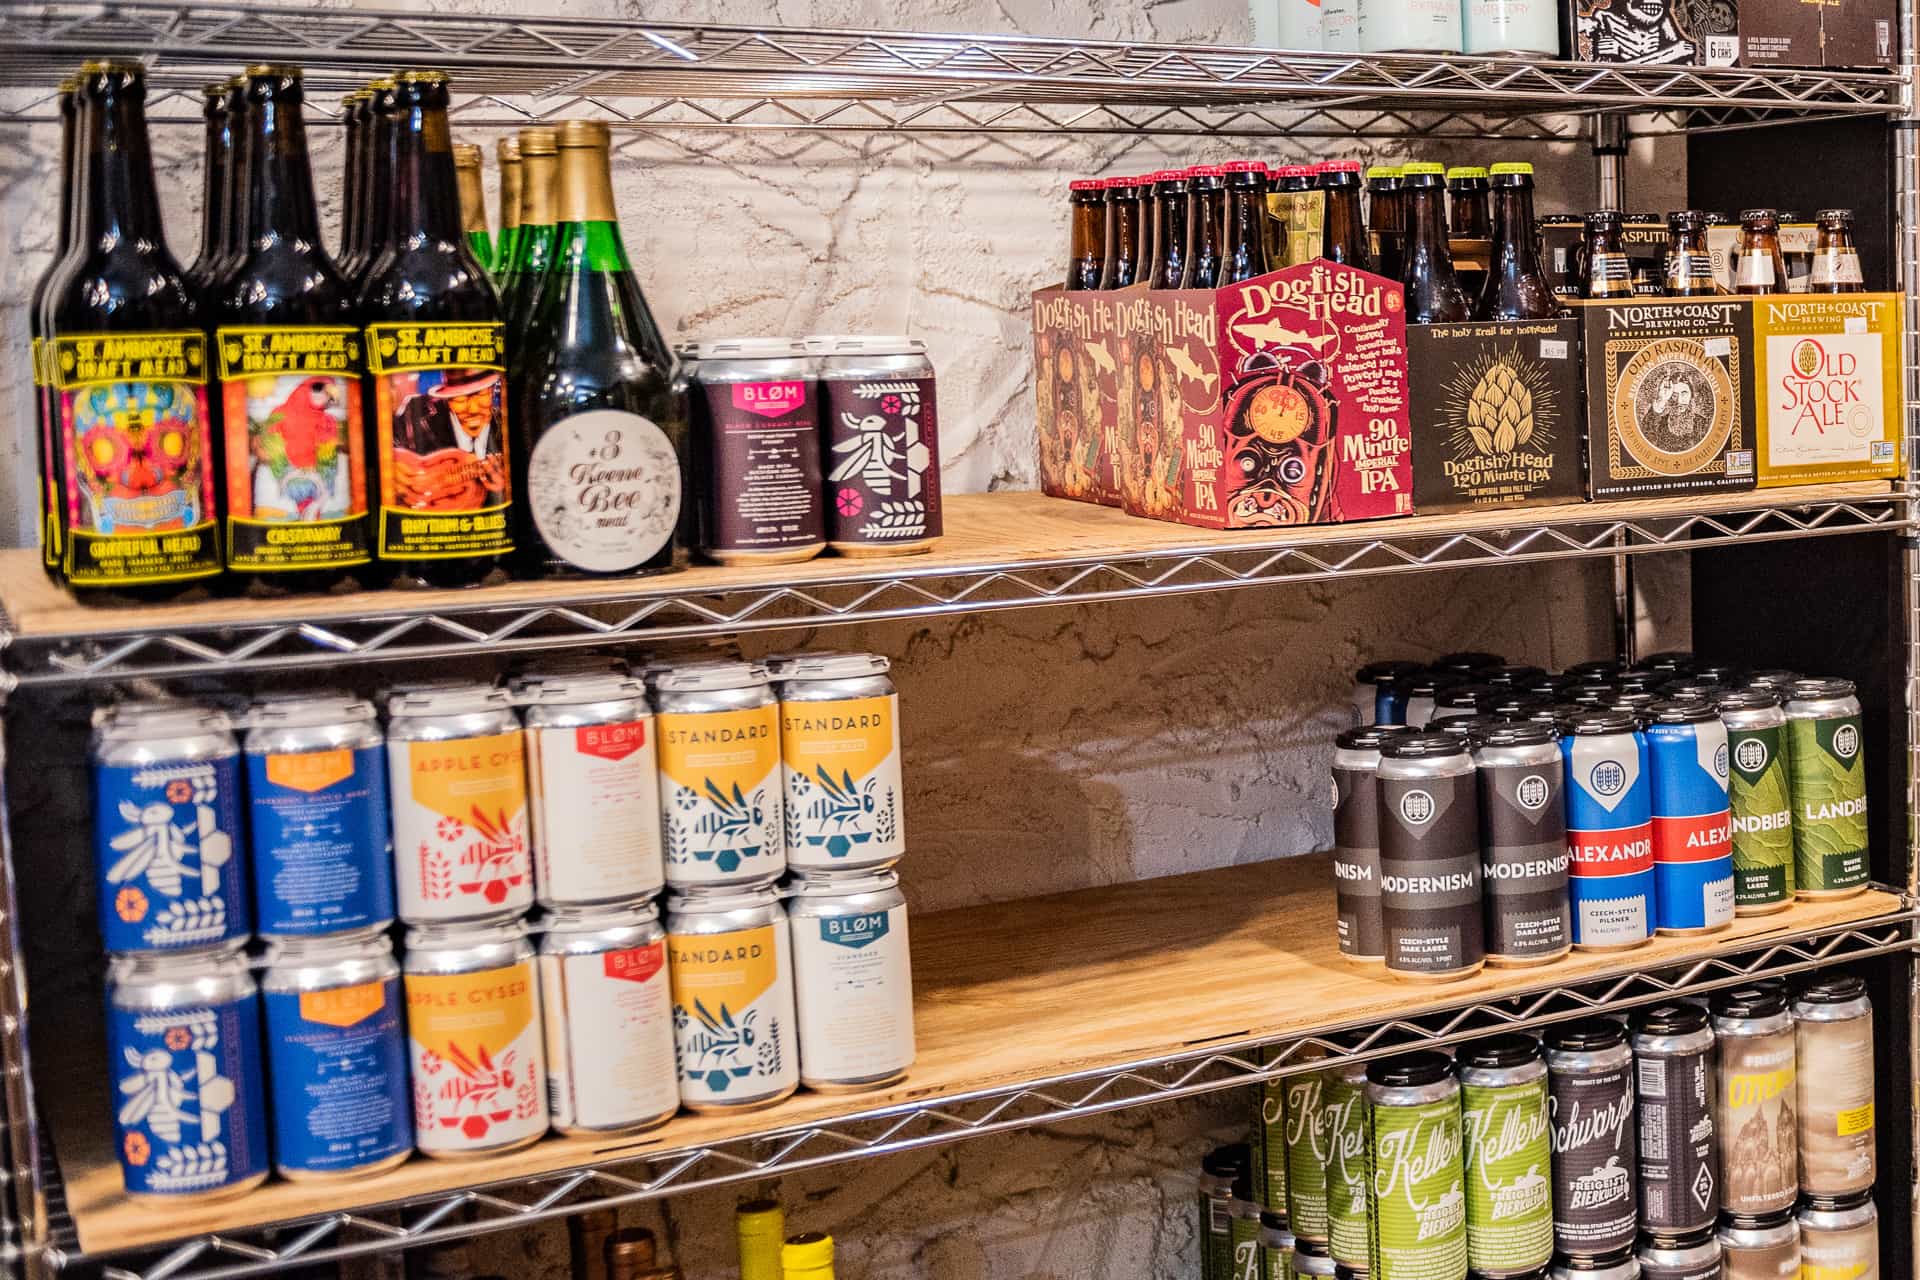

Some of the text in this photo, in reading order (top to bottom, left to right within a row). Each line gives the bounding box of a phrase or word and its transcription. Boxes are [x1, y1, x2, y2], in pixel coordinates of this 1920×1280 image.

[1710, 41, 1716, 58] 6
[1239, 266, 1365, 319] Dogfish
[1308, 286, 1383, 321] Head
[1767, 301, 1882, 325] NORTH COAST
[1035, 296, 1114, 340] Dogfish He
[1116, 297, 1217, 349] Dogfish Head
[1605, 304, 1736, 330] NORTH COAST
[1645, 319, 1708, 329] BREWING CO.
[1801, 315, 1841, 324] BREWING
[270, 333, 347, 352] AMBROSE
[424, 328, 495, 347] AMBROSE
[1431, 327, 1449, 339] The
[1452, 327, 1472, 338] holy
[1499, 326, 1514, 336] for
[1609, 329, 1677, 337] INDEPENDENT
[1681, 328, 1710, 336] SINCE
[104, 338, 184, 359] AMBROSE
[397, 347, 496, 363] DRAFT MEAD
[1628, 341, 1718, 376] OLD RASPUTIN
[77, 359, 187, 379] DRAFT MEAD
[243, 353, 348, 369] DRAFT MEAD
[1656, 352, 1698, 367] IMPERIAL
[1791, 338, 1857, 380] OLD
[743, 385, 798, 402] BLØM
[1782, 375, 1860, 411] STOCK
[1791, 400, 1845, 436] ALE
[1199, 423, 1215, 447] 90
[1368, 418, 1397, 441] 90
[1186, 440, 1224, 470] Minute
[1343, 433, 1409, 463] Minute
[1354, 454, 1399, 468] IMPERIAL
[1443, 450, 1553, 477] Dogfish Head
[1360, 468, 1400, 495] IPA
[1452, 467, 1551, 488] 120 Minute IPA
[1717, 477, 1754, 486] CALIFORNIA
[1195, 481, 1218, 511] IPA
[266, 527, 342, 544] CASTAWAY
[784, 713, 881, 731] STANDARD
[585, 726, 641, 746] BLØM
[668, 723, 769, 745] STANDARD
[415, 754, 481, 773] APPLE
[1731, 810, 1791, 833] NDBIER
[1686, 827, 1732, 848] ALEXA
[1567, 838, 1651, 863] ALEXANDR
[1380, 871, 1473, 894] MODERNISM
[1745, 875, 1769, 883] RUSTIC
[1746, 881, 1769, 889] LAGER
[1590, 906, 1638, 917] CZECH-STYLE
[1598, 915, 1630, 925] PILSNER
[828, 915, 883, 935] BLØM
[1514, 916, 1561, 929] CZECH-STYLE
[1516, 924, 1561, 937] DARK LAGER
[1399, 936, 1449, 945] CZECH-STYLE
[1400, 944, 1448, 953] DARK LAGER
[673, 944, 763, 965] TANDARD
[1569, 1175, 1626, 1191] FREIGEIST
[1569, 1184, 1625, 1210] BIERKULTUR
